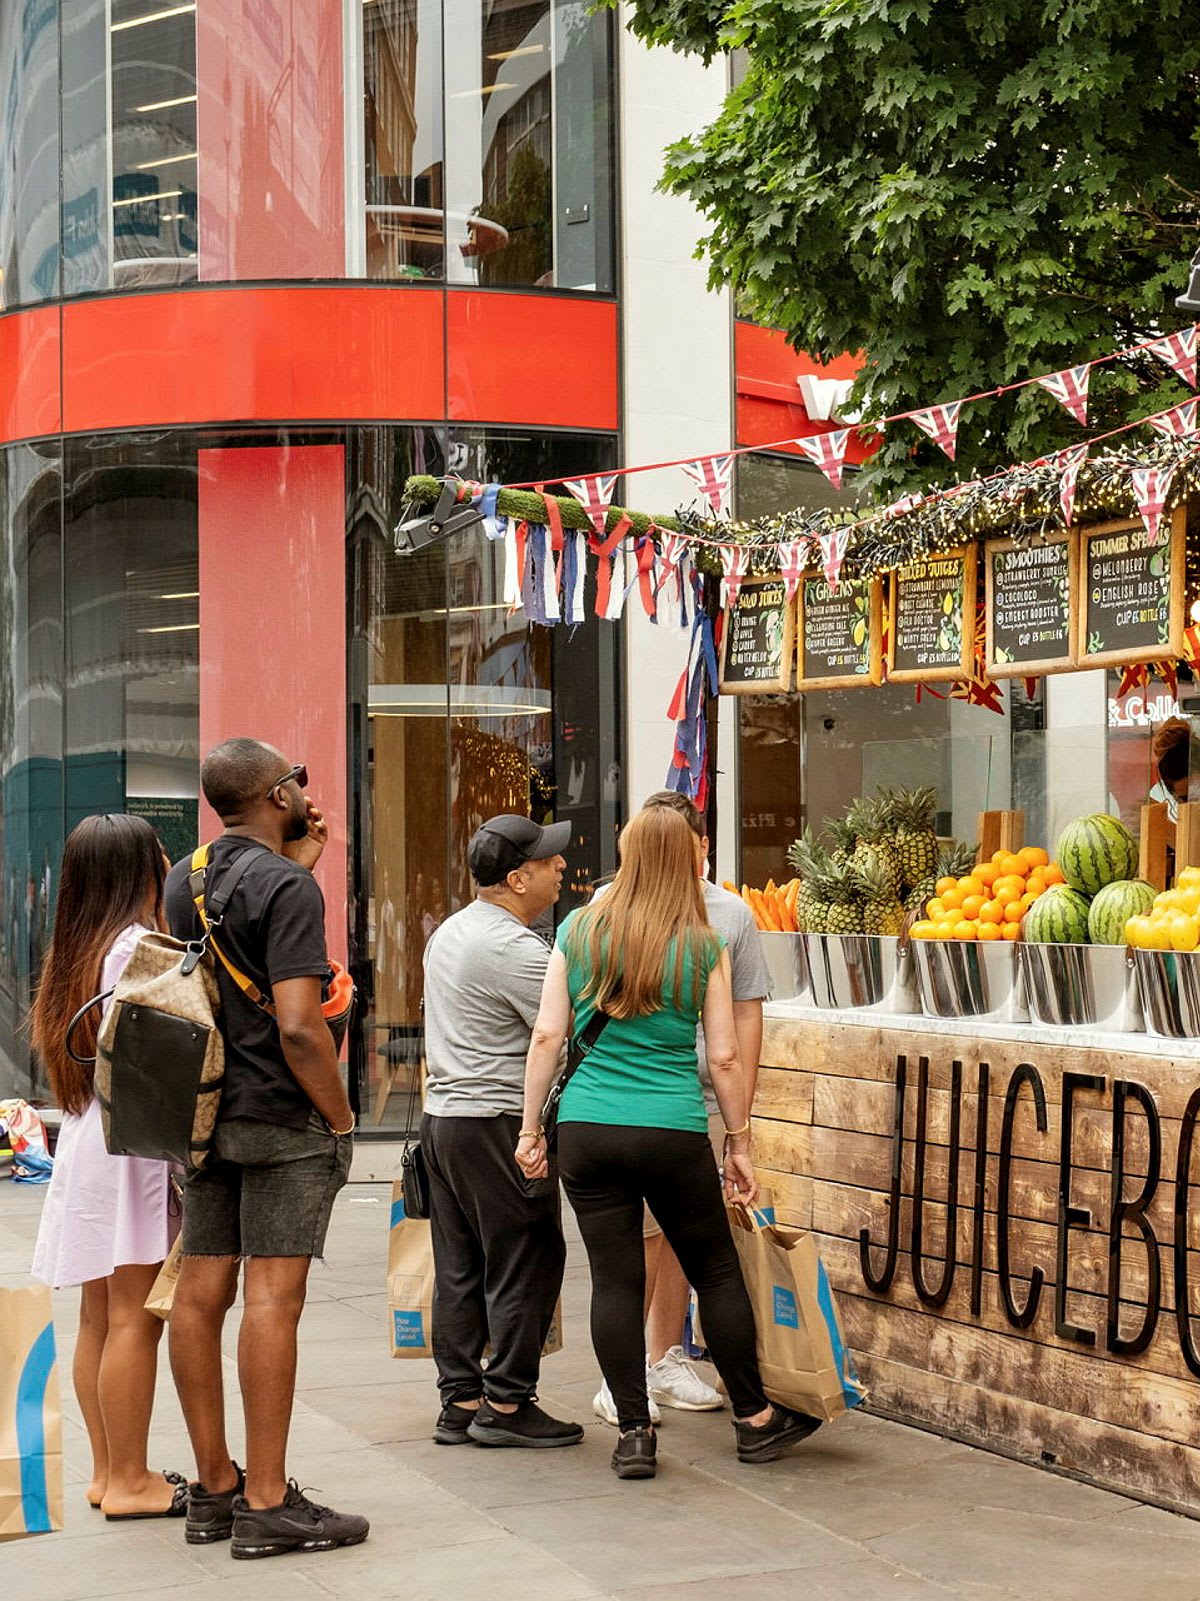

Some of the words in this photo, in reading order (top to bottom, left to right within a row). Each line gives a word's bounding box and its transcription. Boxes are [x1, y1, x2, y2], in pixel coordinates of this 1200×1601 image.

[1090, 535, 1128, 558] SUMMER
[1005, 545, 1060, 570] SMOOTHIES
[1102, 556, 1148, 576] MELONBERRY
[928, 560, 959, 578] JUICES
[1005, 569, 1040, 583] STRAWBERRY
[759, 590, 782, 607] JUICES
[1005, 590, 1037, 603] COCOLOCO
[1102, 584, 1134, 602] ENGLISH
[1138, 580, 1158, 595] ROSE
[1005, 610, 1029, 623] ENERGY
[1030, 606, 1058, 619] BOOSTER
[1117, 610, 1132, 626] CUP
[1140, 608, 1158, 623] BOTTLE
[1019, 633, 1031, 646] CUP
[1040, 630, 1055, 642] BOTTLE
[828, 655, 836, 666] CUP
[917, 653, 928, 664] CUP
[744, 666, 754, 677] CUP
